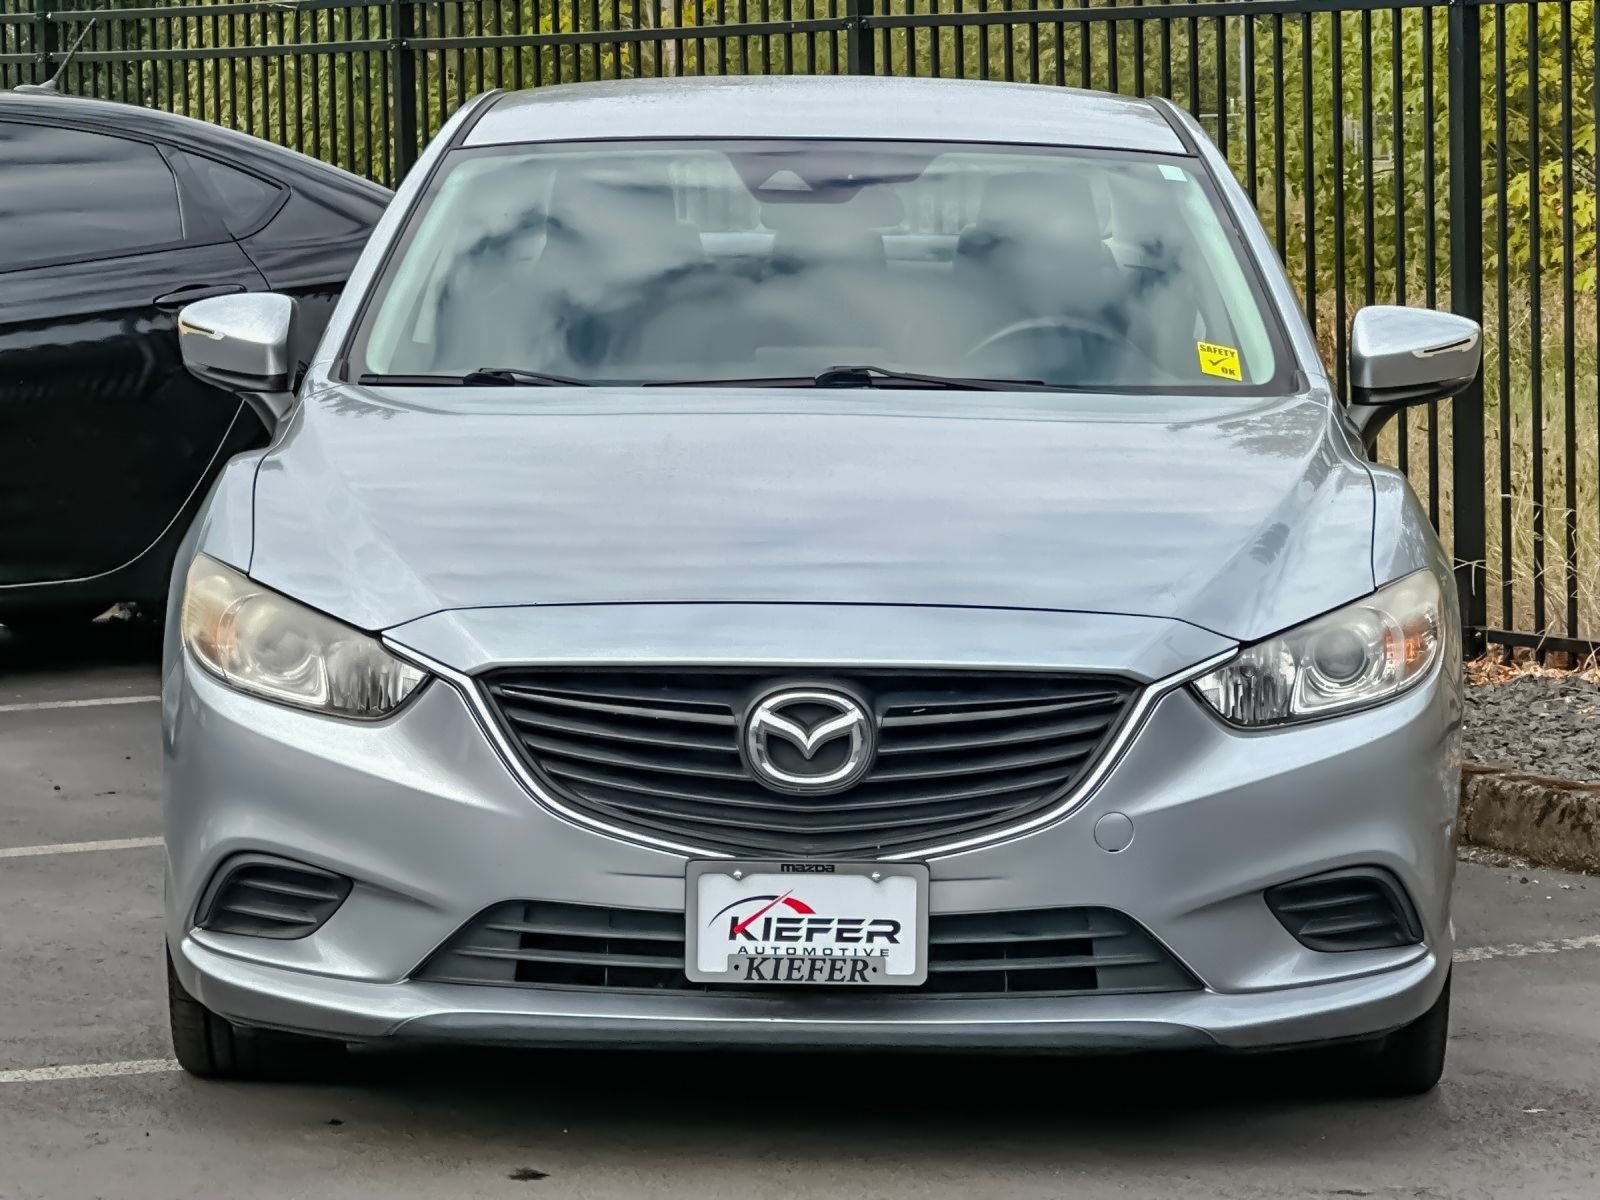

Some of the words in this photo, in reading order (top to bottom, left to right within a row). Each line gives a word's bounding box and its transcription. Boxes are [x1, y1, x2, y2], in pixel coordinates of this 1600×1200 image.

[1200, 344, 1235, 358] SAFETY
[1220, 367, 1236, 376] OK
[728, 916, 901, 944] KIEFER
[738, 946, 889, 957] AUTOMOTIVE
[743, 957, 871, 982] KIEFER
